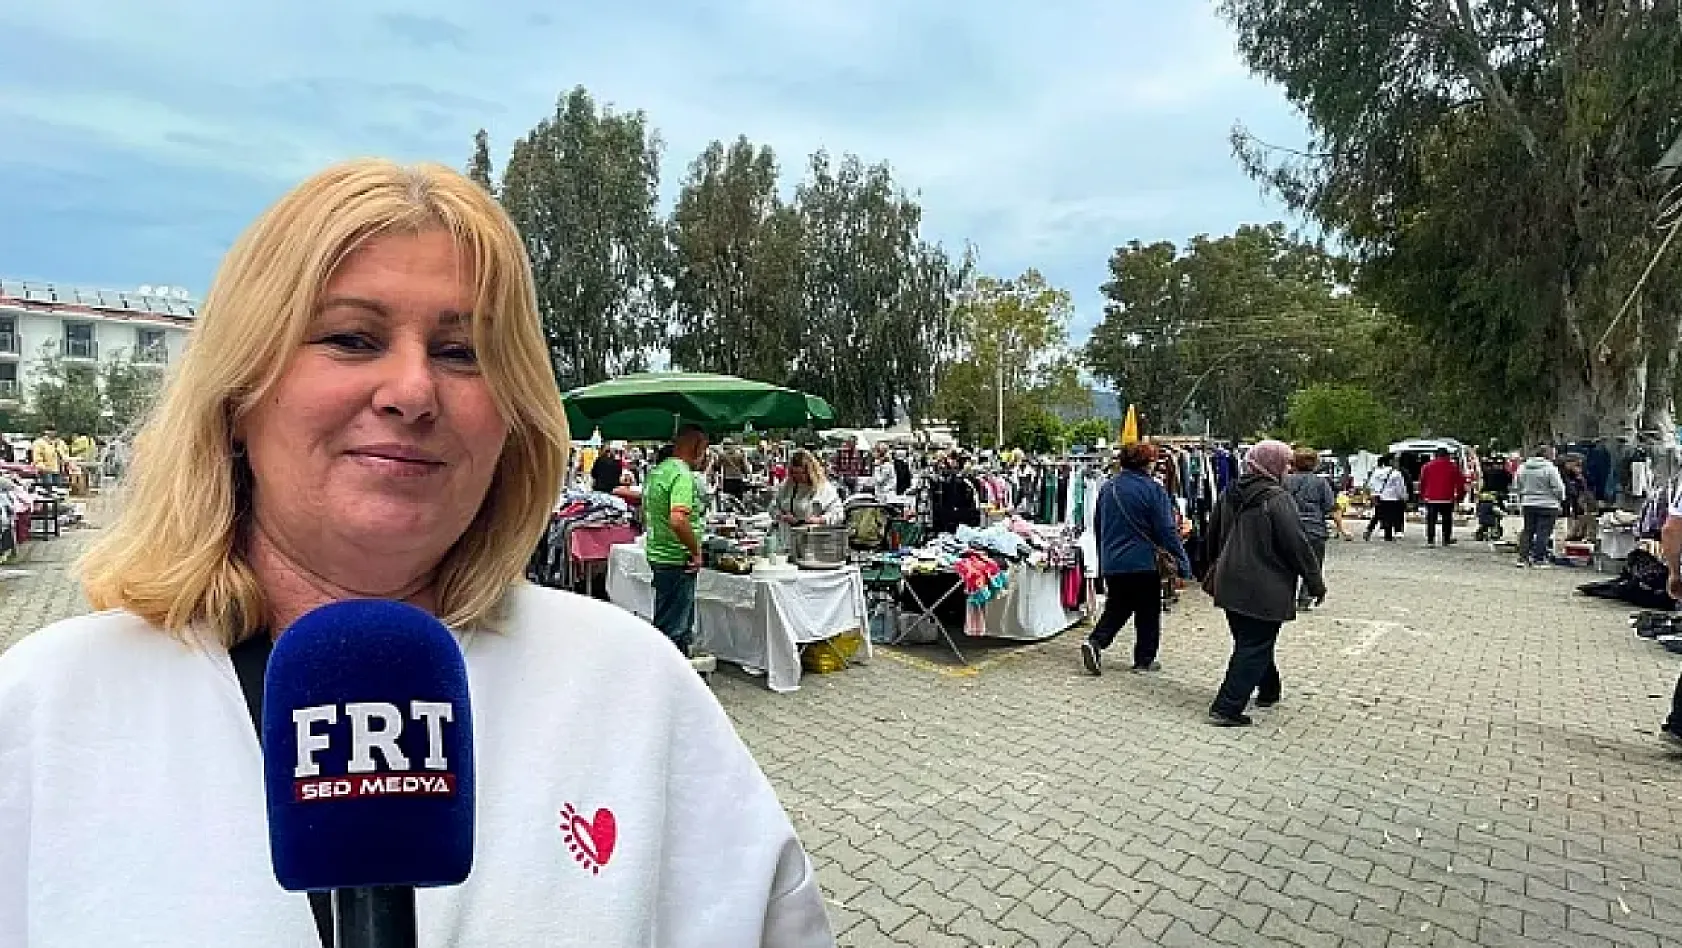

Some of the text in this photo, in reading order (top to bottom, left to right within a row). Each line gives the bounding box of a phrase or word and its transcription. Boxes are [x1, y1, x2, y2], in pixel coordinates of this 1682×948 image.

[293, 700, 453, 777] FRT
[302, 776, 450, 799] SED MEDYA
